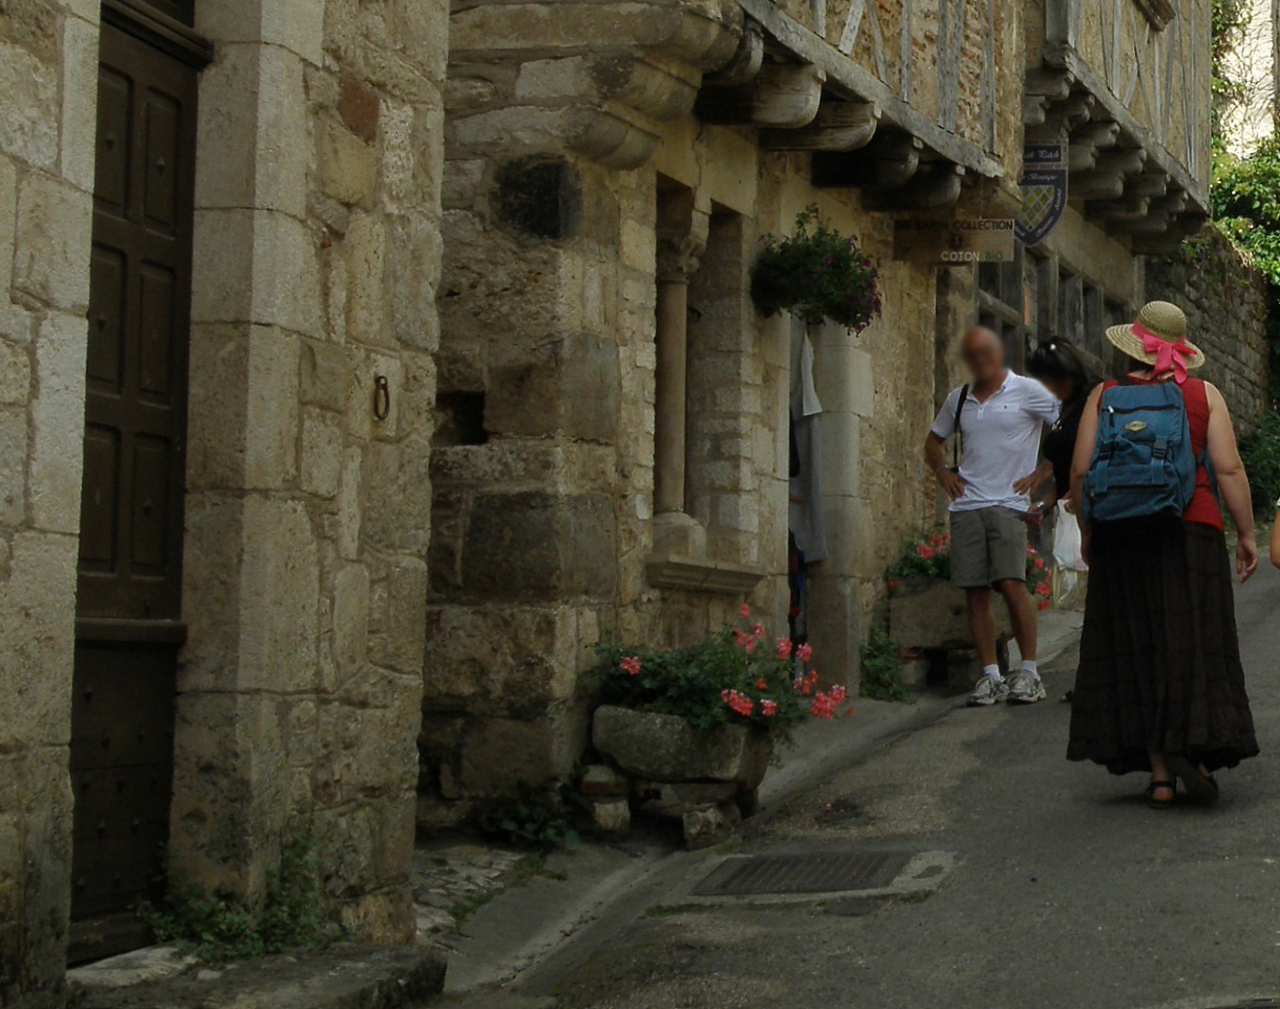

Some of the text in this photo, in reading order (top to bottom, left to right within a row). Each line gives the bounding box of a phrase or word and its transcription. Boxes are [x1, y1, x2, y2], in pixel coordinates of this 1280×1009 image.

[953, 220, 1013, 230] COLLECTION
[940, 250, 1003, 262] COTON BIO
